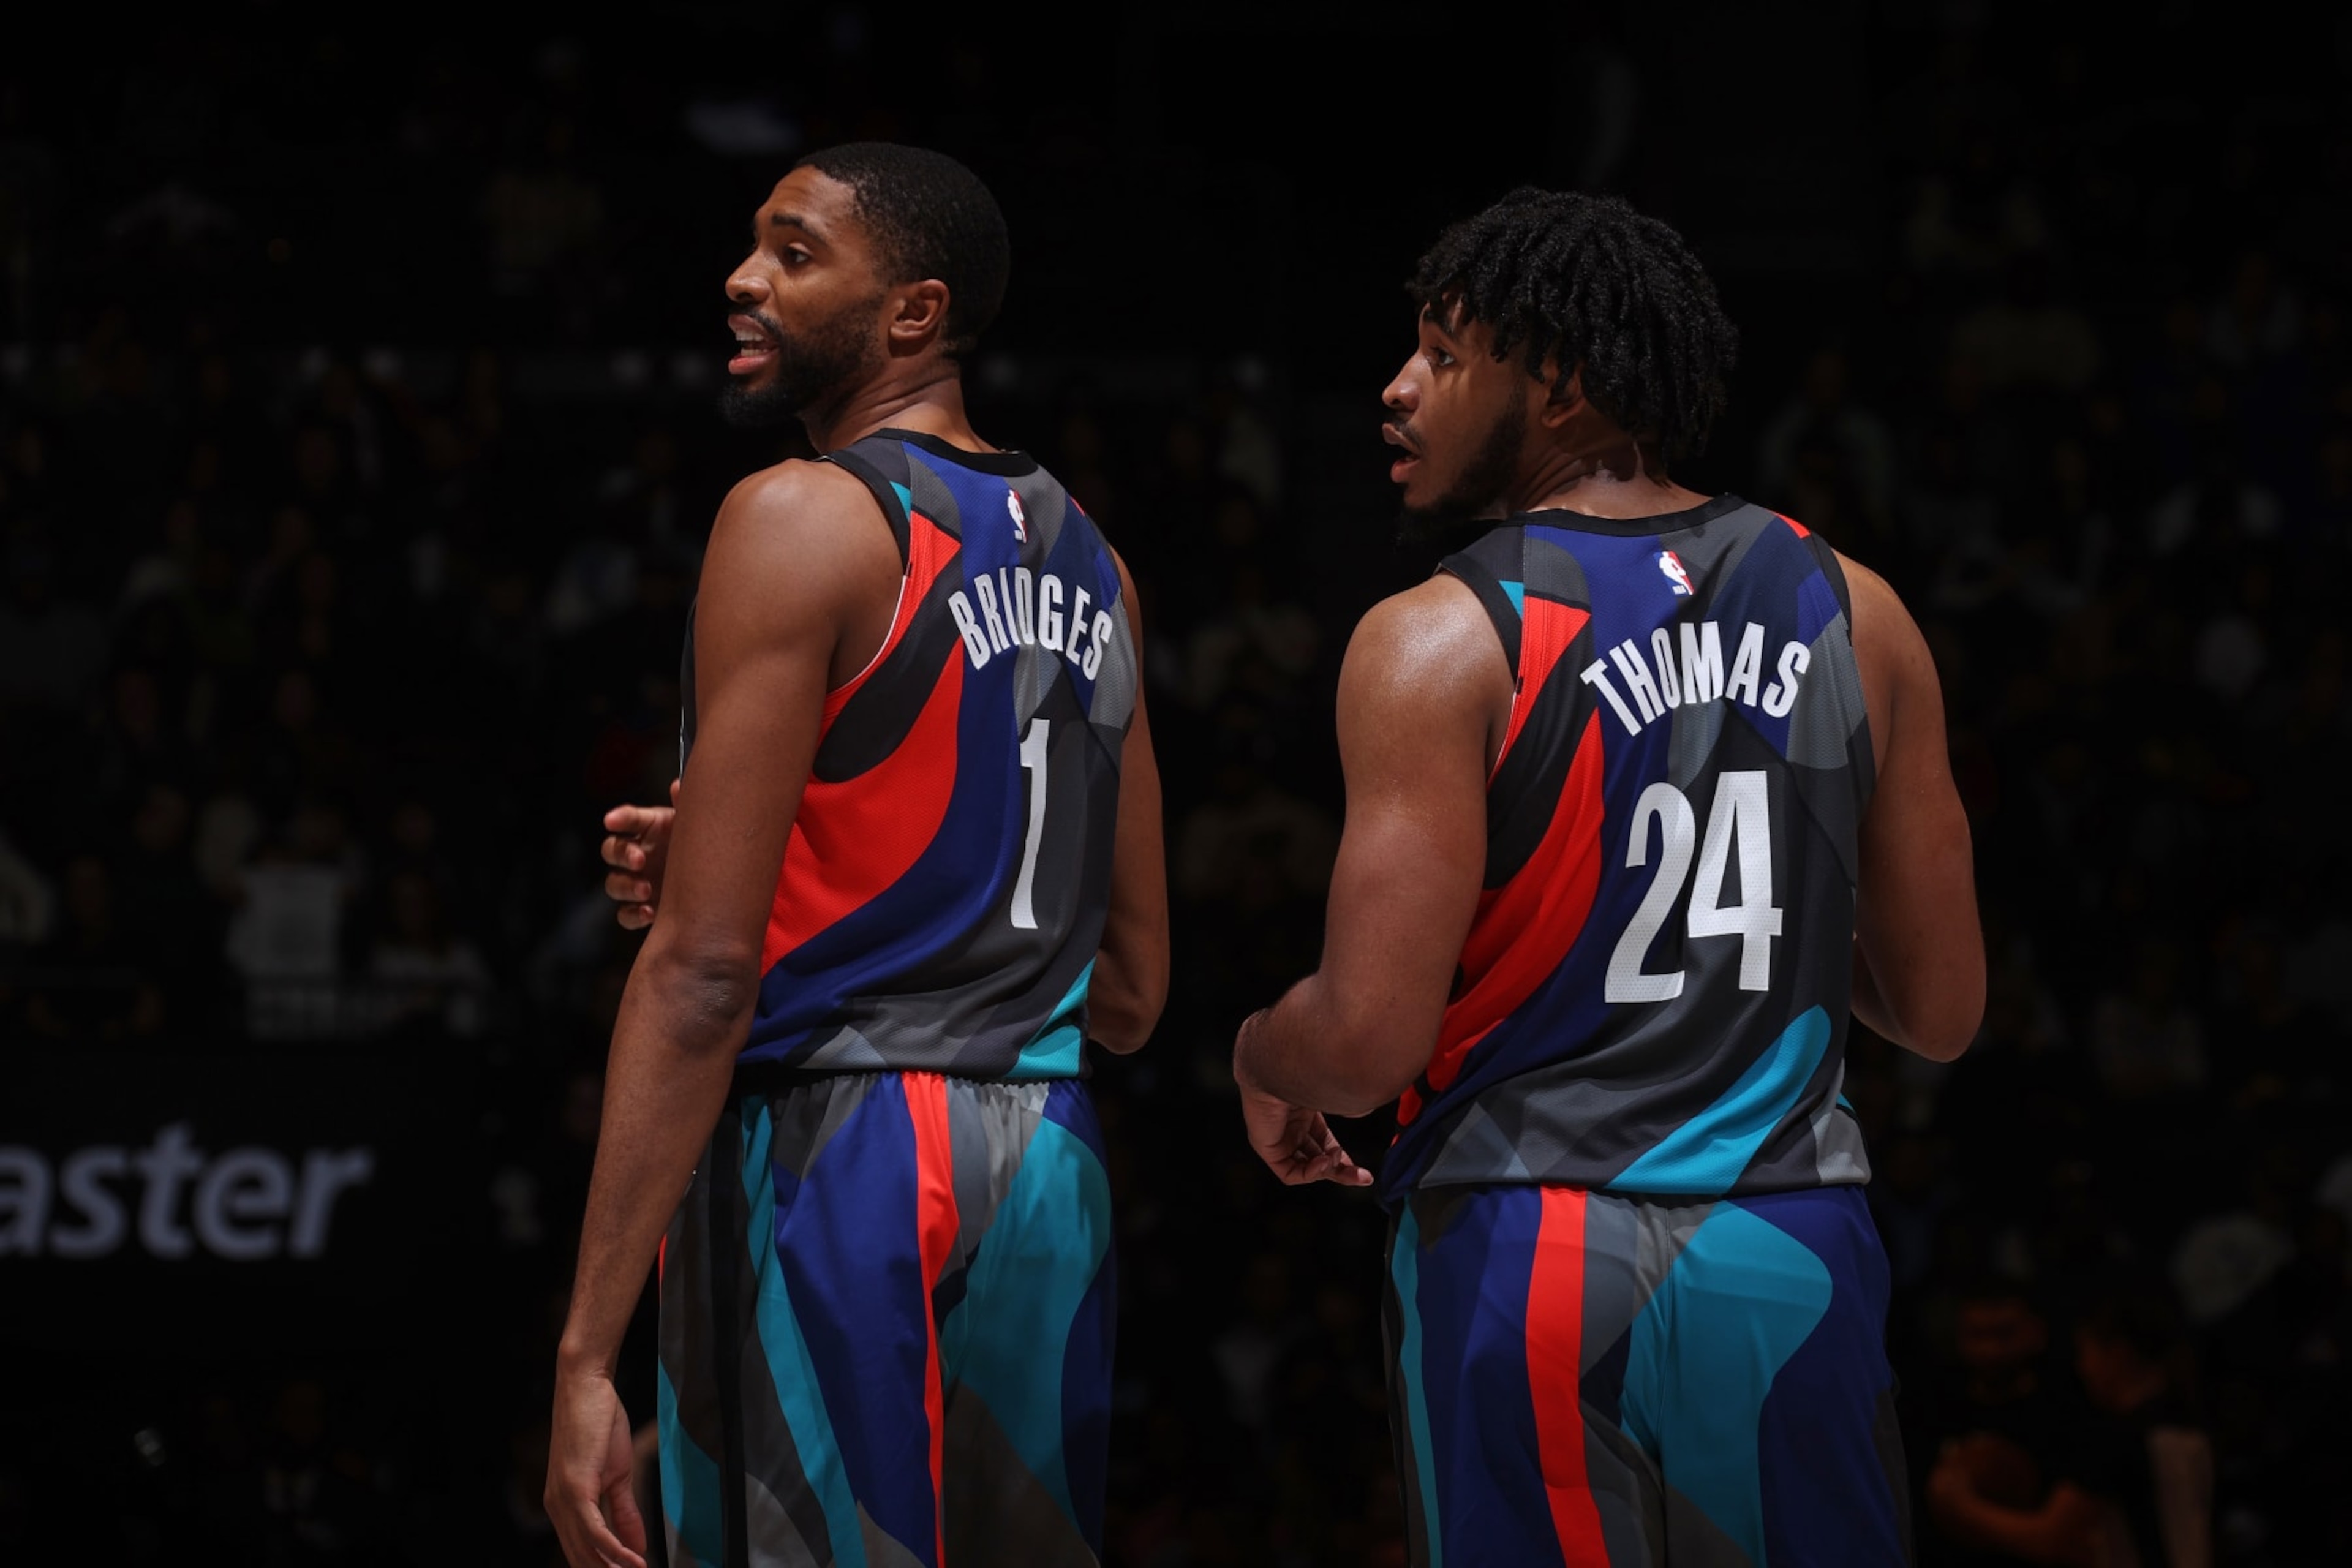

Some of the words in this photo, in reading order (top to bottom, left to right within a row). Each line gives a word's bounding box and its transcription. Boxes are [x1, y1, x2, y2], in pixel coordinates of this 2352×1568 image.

[948, 567, 1113, 680] BRIDGES
[1580, 621, 1811, 736] THOMAS
[1011, 718, 1050, 929] 1
[1605, 770, 1783, 1003] 24
